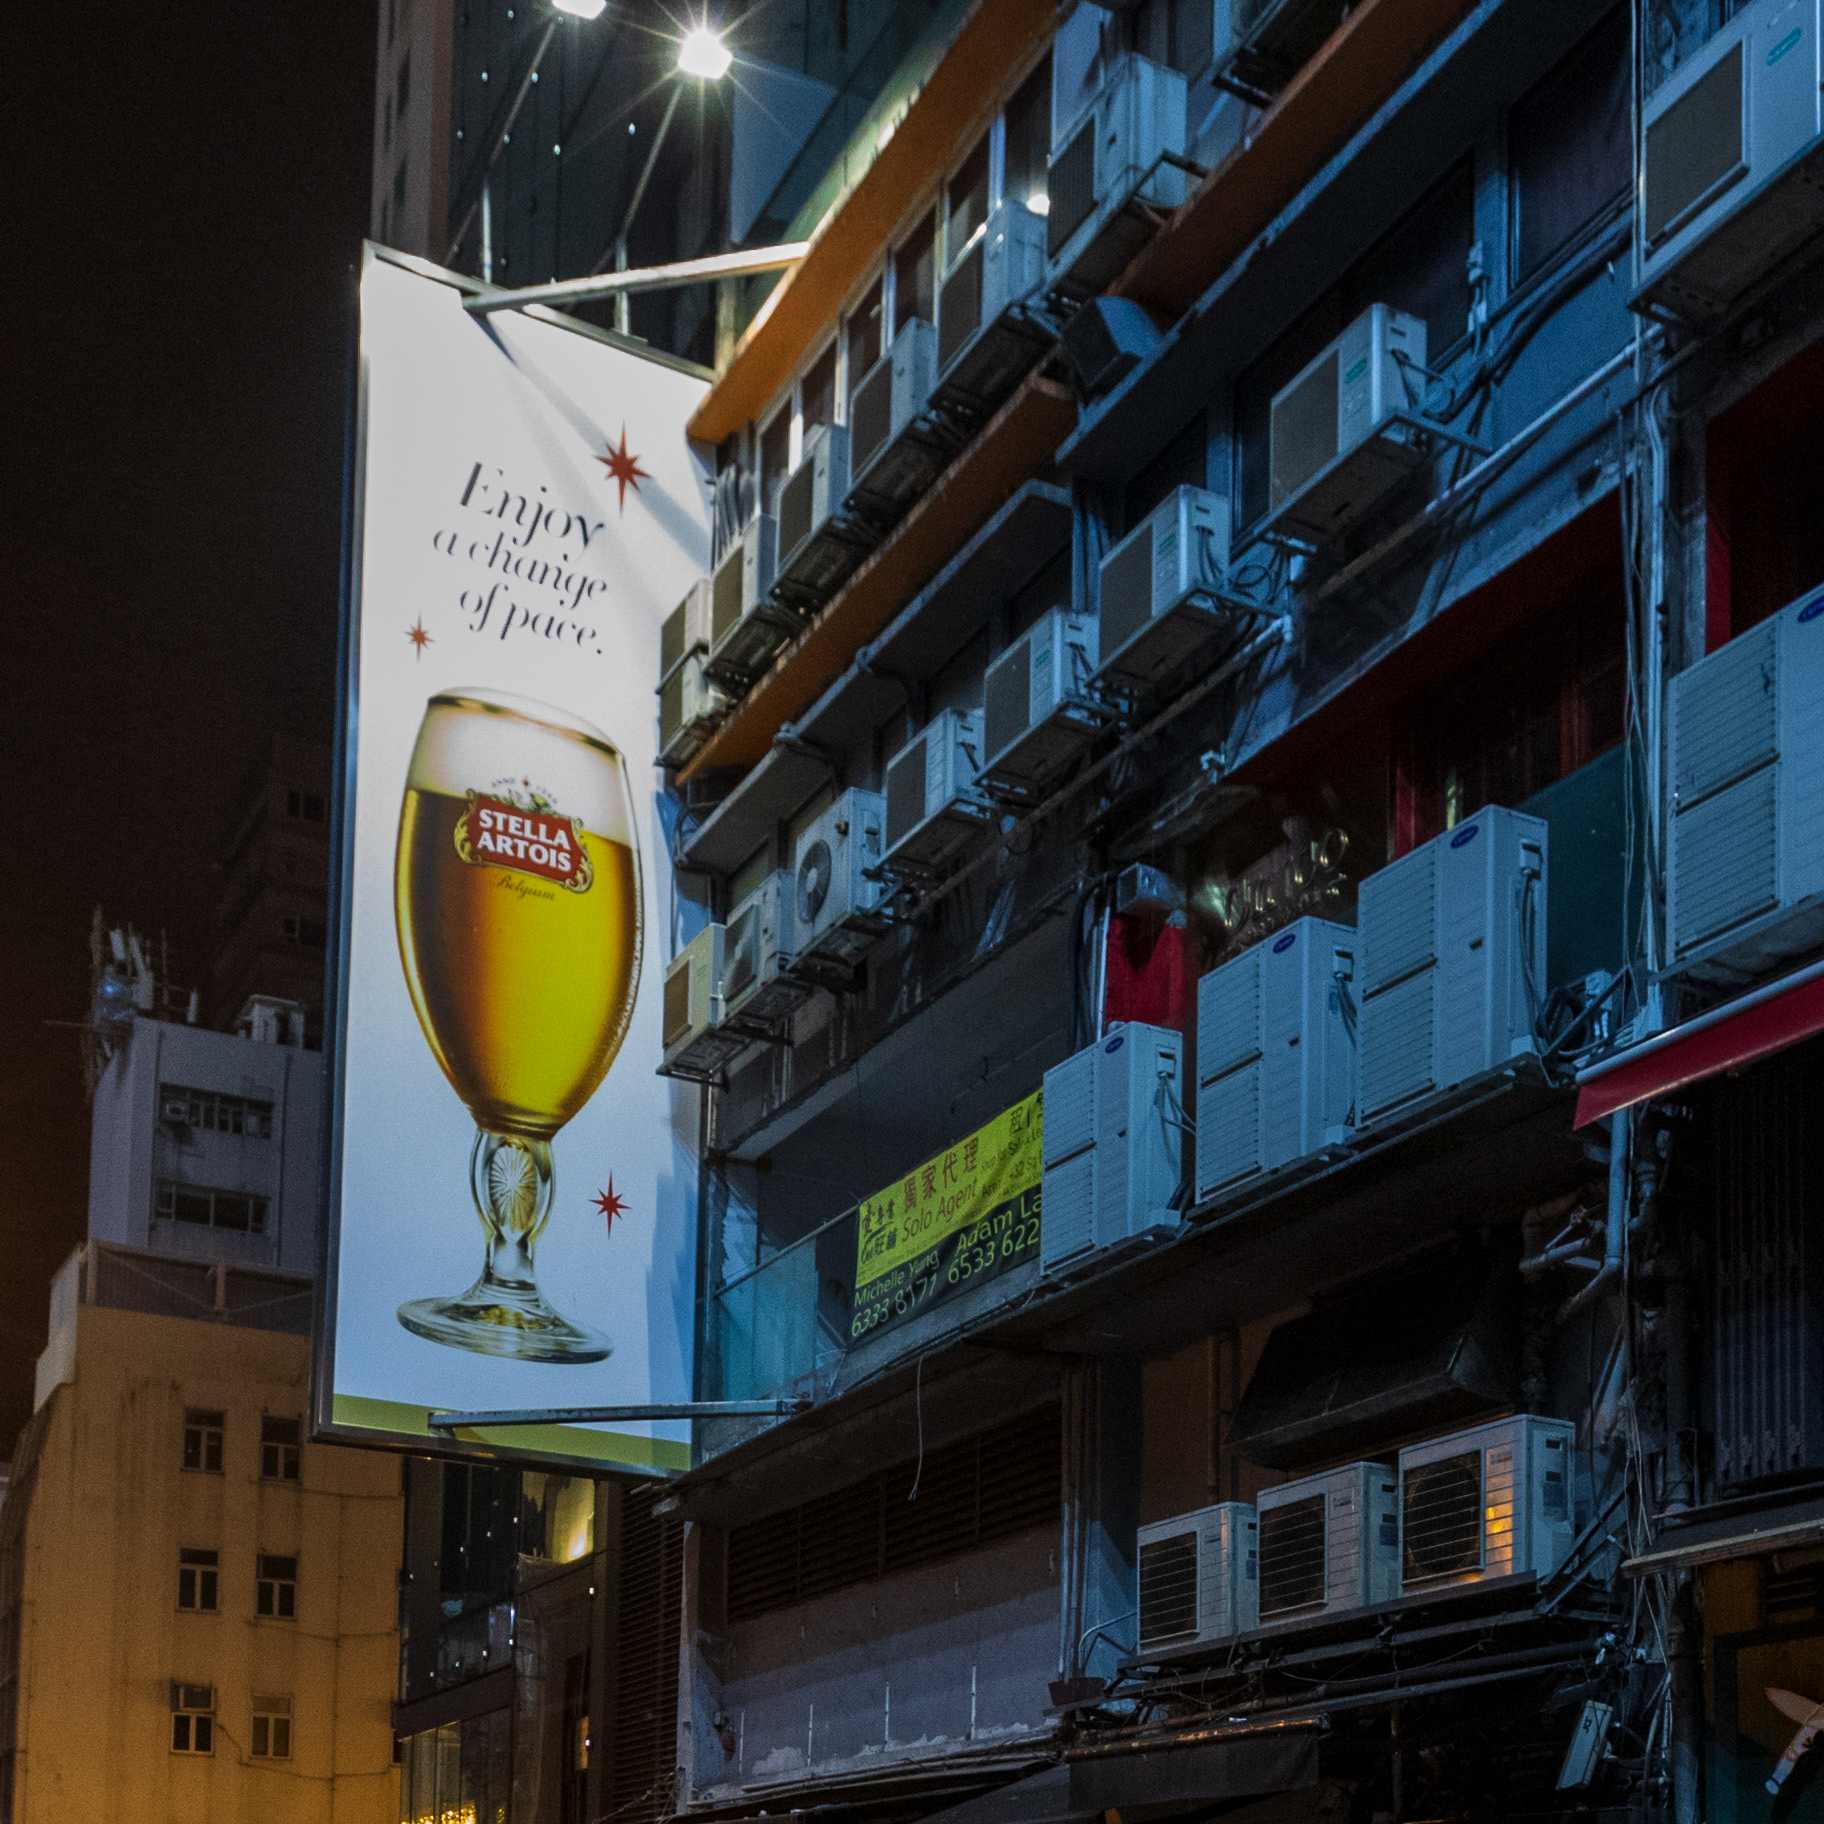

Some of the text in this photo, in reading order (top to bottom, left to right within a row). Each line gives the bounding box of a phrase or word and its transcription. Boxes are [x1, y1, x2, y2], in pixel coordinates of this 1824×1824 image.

[459, 461, 606, 551] Enjoy
[432, 527, 608, 608] a change
[459, 583, 603, 656] of pace.
[476, 830, 572, 873] ARTOIS
[478, 808, 571, 851] STELLA
[901, 1207, 933, 1242] Solo
[936, 1178, 977, 1224] Agent
[853, 1270, 906, 1309] Michelle
[947, 1240, 997, 1285] 6533
